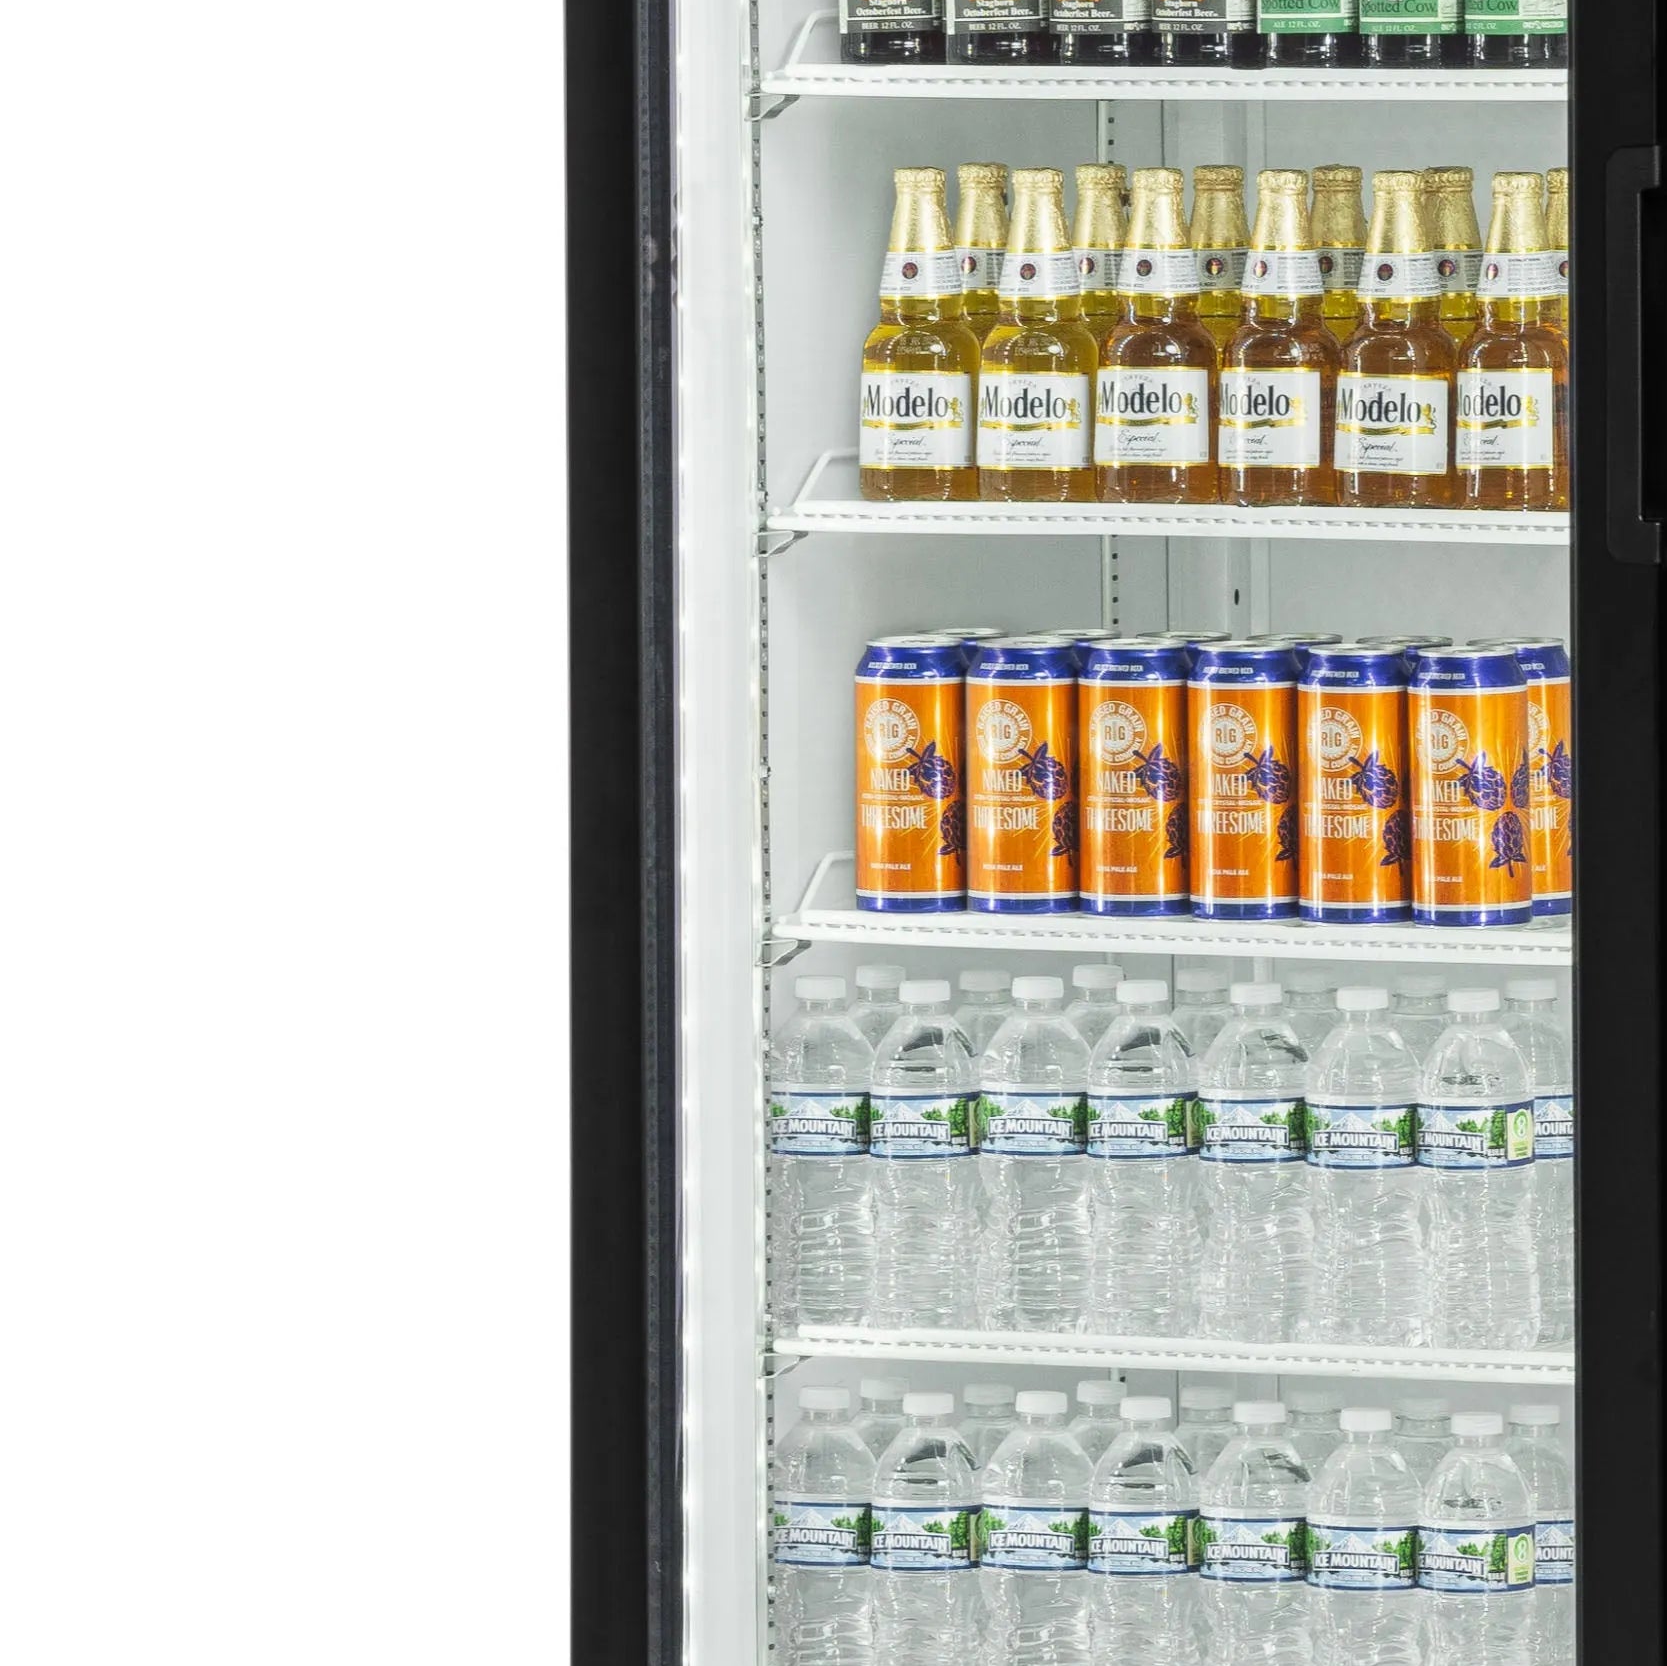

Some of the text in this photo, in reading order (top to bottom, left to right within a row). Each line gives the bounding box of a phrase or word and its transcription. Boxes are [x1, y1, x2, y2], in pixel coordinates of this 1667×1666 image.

[867, 384, 950, 419] Modelo
[984, 384, 1067, 419] Modelo
[1101, 379, 1183, 416] Modelo
[1342, 384, 1421, 423] Modelo
[871, 769, 909, 791] NAKED
[1097, 772, 1136, 794] NAKED
[989, 1119, 1072, 1136] ICE MOUNTAIN
[1314, 1133, 1397, 1151] ICE MOUNTAIN
[991, 1533, 1073, 1550] ICE MOUNTAIN
[1315, 1553, 1398, 1572] ICE MOUNTAIN
